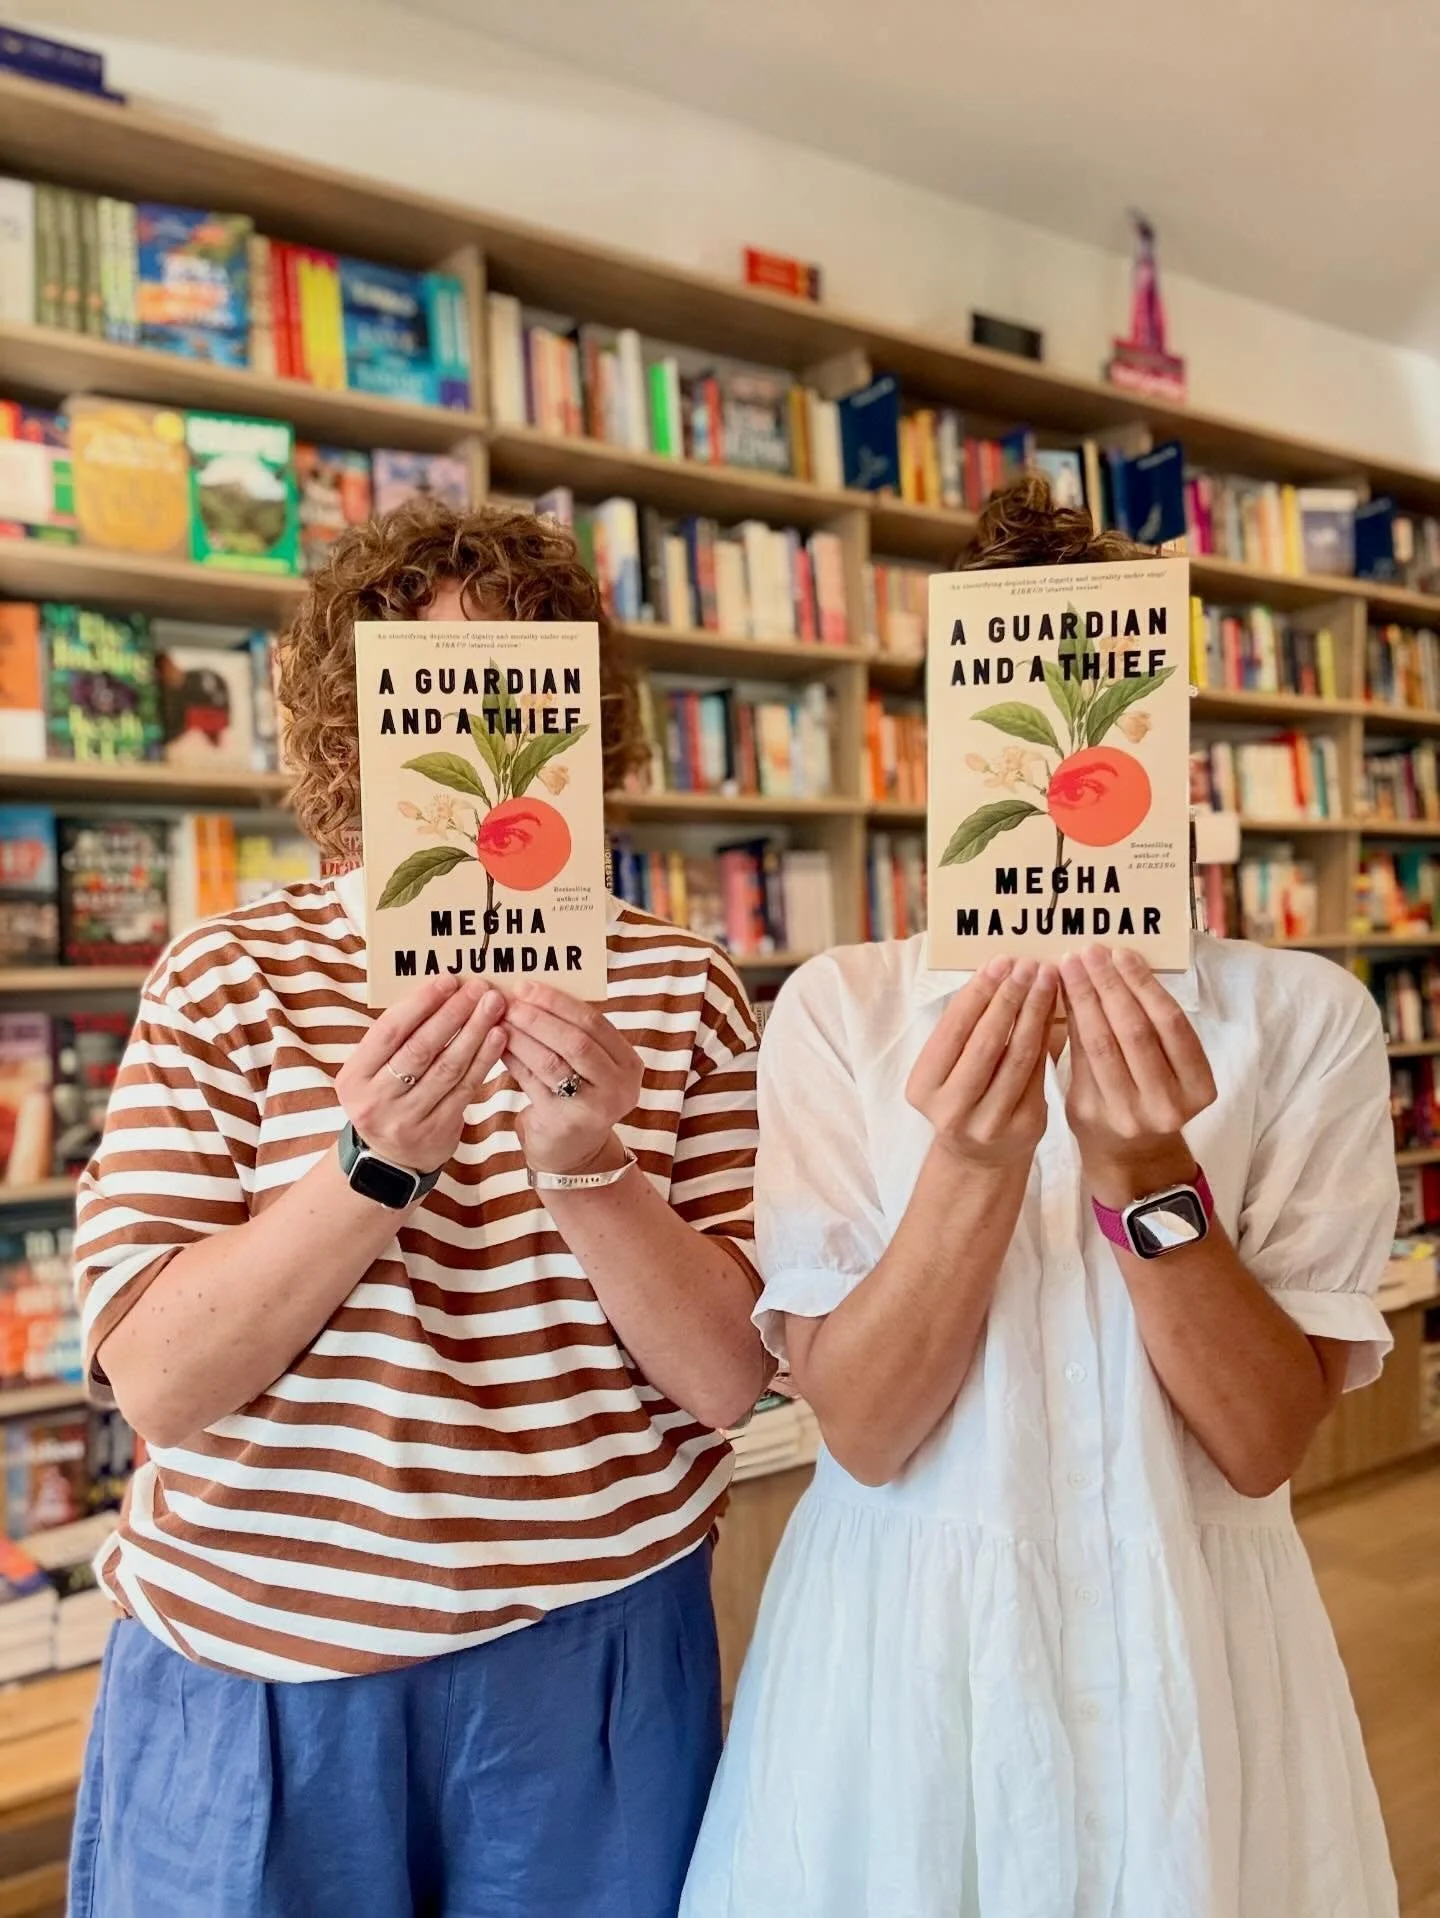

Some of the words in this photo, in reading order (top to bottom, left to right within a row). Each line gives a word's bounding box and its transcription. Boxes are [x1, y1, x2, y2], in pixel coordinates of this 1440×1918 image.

[951, 619, 966, 645] A
[988, 607, 1167, 643] GUARDIAN
[379, 668, 395, 695] A
[415, 668, 581, 695] GUARDIAN
[951, 658, 1014, 686] AND
[1029, 655, 1045, 682] A
[1059, 649, 1167, 681] THIEF
[380, 708, 442, 735] AND
[456, 708, 472, 734] A
[484, 707, 581, 735] THIEF
[995, 867, 1120, 895] MEGHA
[430, 908, 546, 937] MEGHA
[957, 907, 1161, 936] MAJUMDAR
[395, 945, 582, 977] MAJUMDAR
